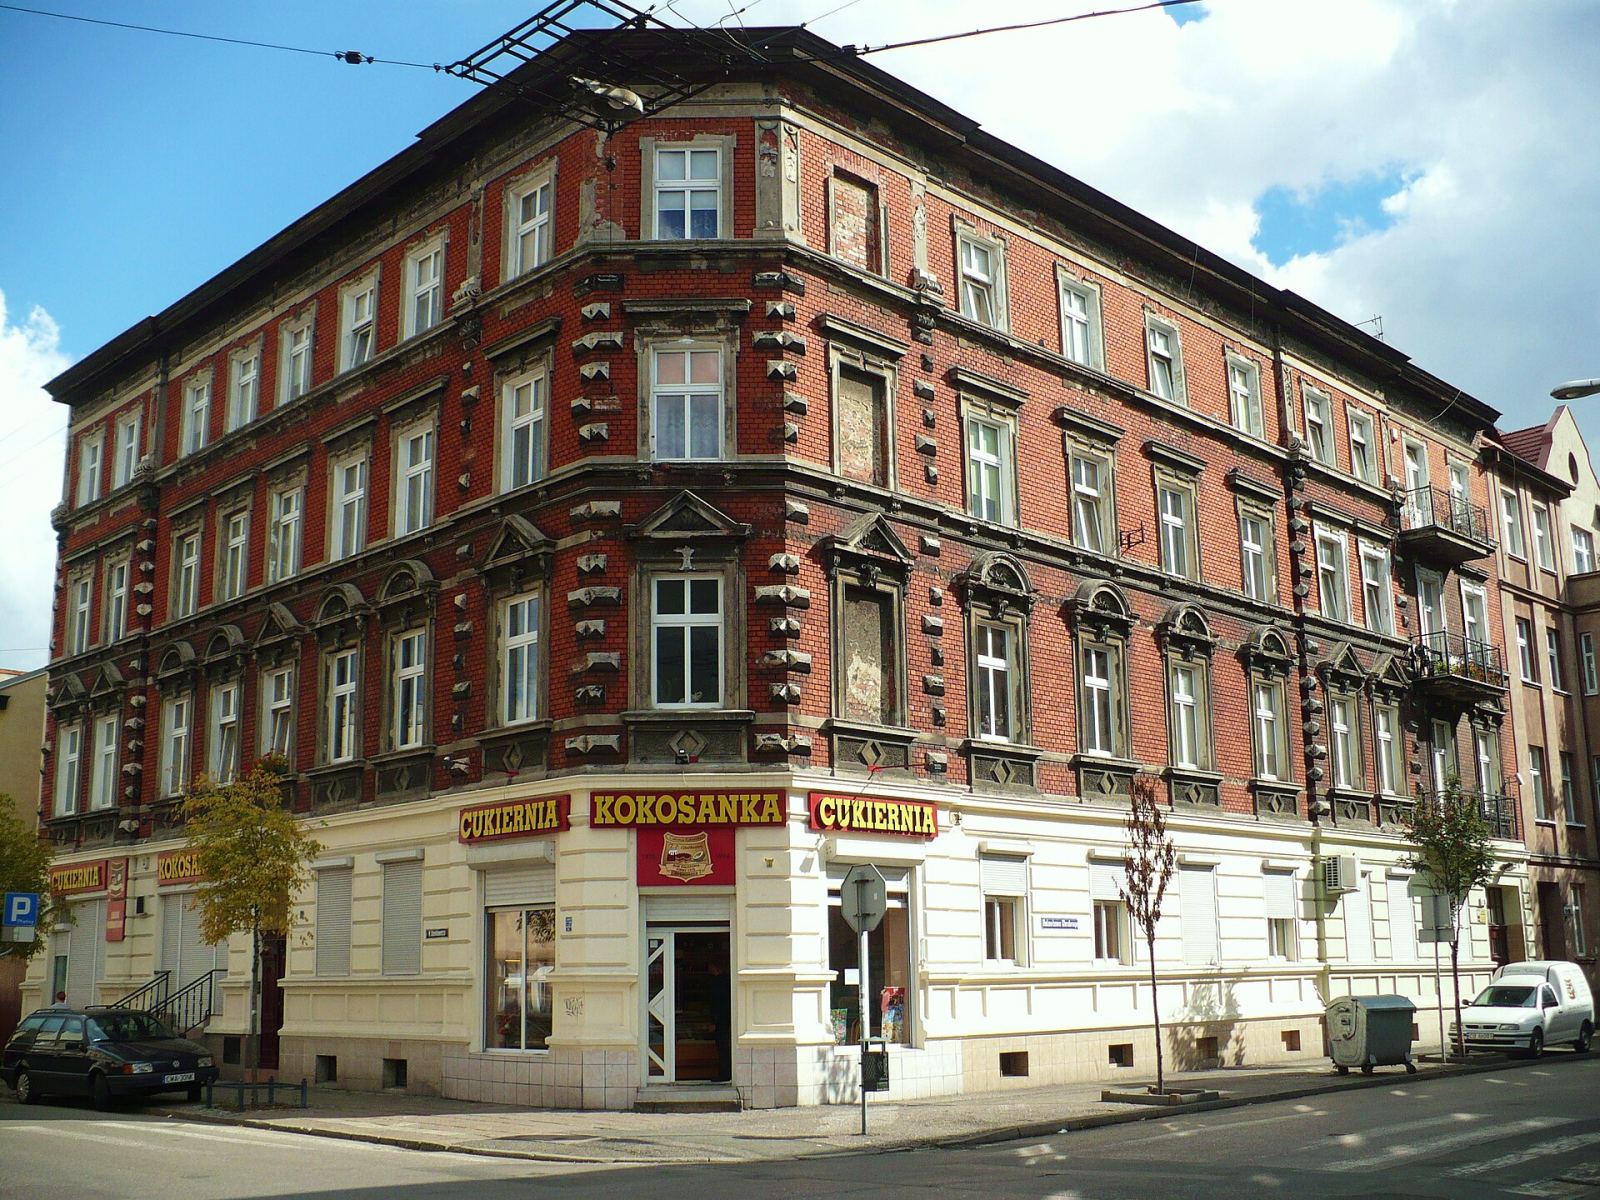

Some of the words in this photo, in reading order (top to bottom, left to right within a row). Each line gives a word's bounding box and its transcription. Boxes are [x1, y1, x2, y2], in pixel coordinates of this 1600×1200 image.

[461, 800, 557, 838] CUKIERNIA
[594, 794, 781, 824] KOKOSANKA
[819, 797, 936, 834] CUKIERNIA
[52, 866, 99, 890] CUKIERNIA
[159, 854, 203, 879] KOKOSA
[11, 896, 31, 922] P
